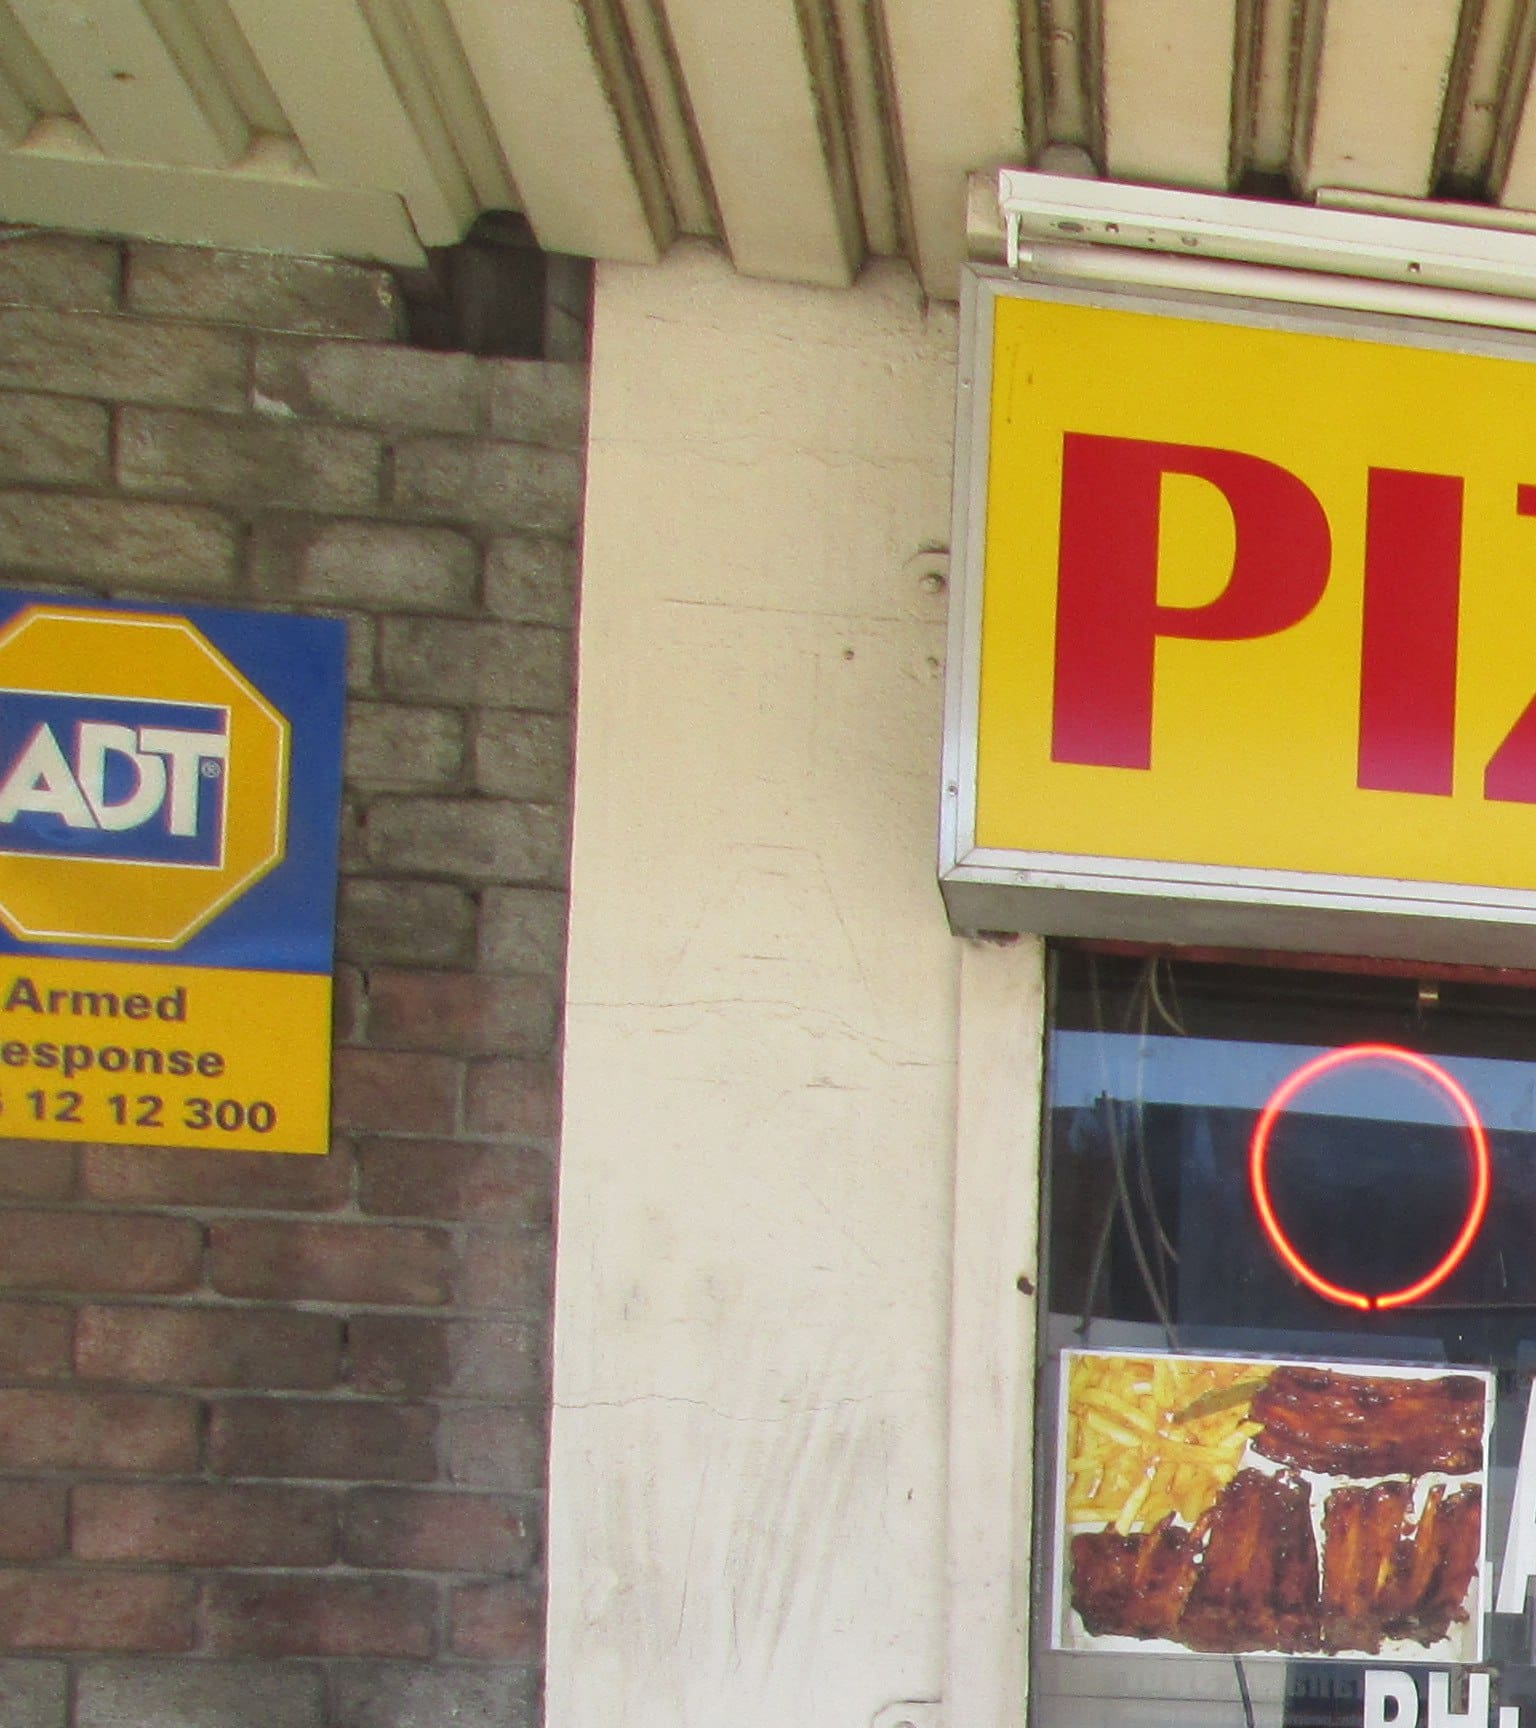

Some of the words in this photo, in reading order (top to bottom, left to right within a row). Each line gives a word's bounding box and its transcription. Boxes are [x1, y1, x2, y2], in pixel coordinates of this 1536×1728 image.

[0, 721, 229, 838] ADT
[4, 977, 188, 1022] Armed
[0, 1039, 226, 1079] esponse
[27, 1089, 84, 1124] 12
[108, 1094, 164, 1128] 12
[183, 1096, 277, 1134] 300
